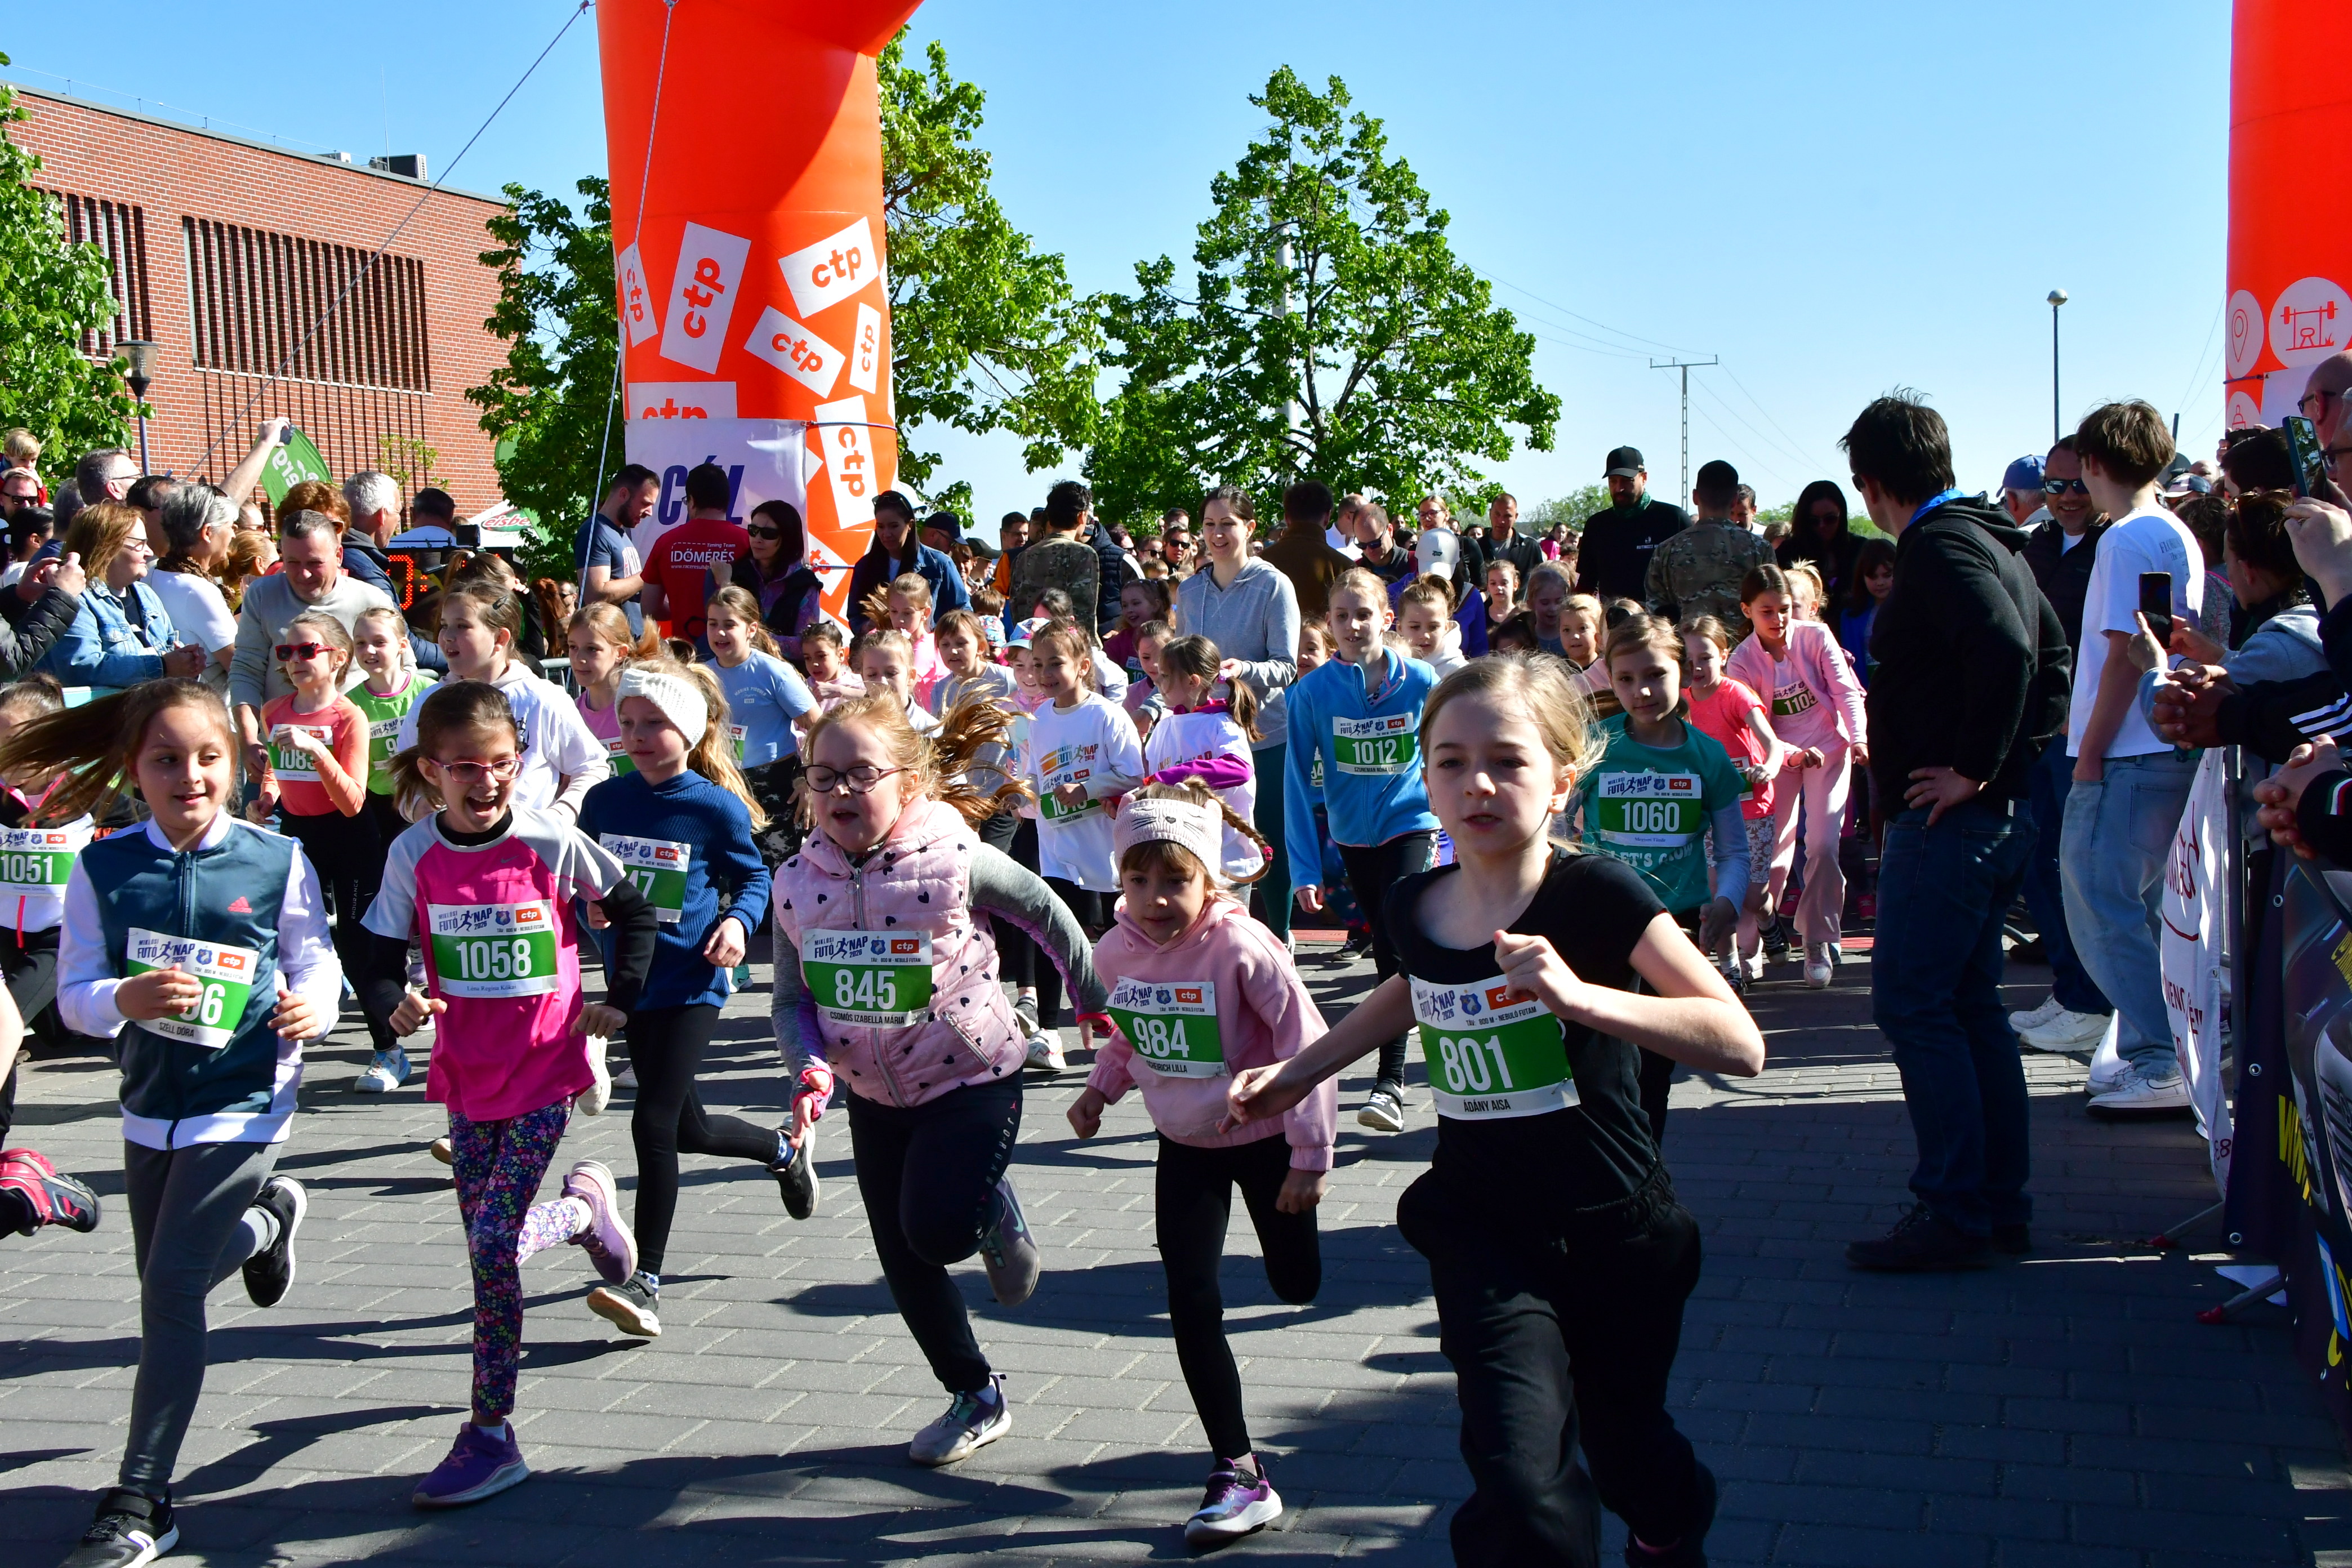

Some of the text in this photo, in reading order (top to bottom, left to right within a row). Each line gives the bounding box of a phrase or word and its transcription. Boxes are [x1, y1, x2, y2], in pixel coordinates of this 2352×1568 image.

[812, 247, 861, 288] ctp
[627, 268, 643, 322] ctp
[683, 257, 725, 338] ctp
[772, 333, 823, 372] ctp
[860, 324, 875, 372] ctp
[838, 426, 865, 497] ctp
[658, 455, 745, 525] CL
[671, 548, 734, 563] IDŐMÉRÉS
[809, 549, 831, 574] tp
[389, 719, 398, 728] NAP
[1340, 720, 1373, 734] FUTÓ NAP
[1084, 743, 1099, 755] NAP
[1352, 739, 1397, 764] 1012
[1608, 776, 1652, 795] FUTÓ NAP
[1050, 795, 1087, 816] 10
[1622, 801, 1680, 832] 1060
[15, 831, 29, 841] NAP
[624, 841, 638, 852] NAP
[1, 854, 53, 883] 1051
[439, 907, 492, 932] FUTÓ NAP
[521, 910, 538, 920] ctp
[474, 920, 487, 930] 2026
[814, 937, 834, 946] MIKLÓSI
[814, 936, 868, 958] FUTÓ NAP
[897, 942, 914, 951] ctp
[137, 943, 195, 959] FUTÓ NAP
[456, 938, 532, 979] 1058
[849, 949, 862, 958] 2026
[223, 956, 241, 967] ctp
[835, 969, 896, 1010] 845
[1114, 987, 1152, 1005] FUTÓ NAP
[1181, 992, 1197, 1000] ctp
[1438, 990, 1455, 1009] NAP
[830, 1011, 905, 1024] CSOMÓS IZABELLA MÁRIA
[1442, 1009, 1455, 1021] 2026
[1498, 1011, 1518, 1021] NEBULÓ
[1519, 1006, 1536, 1016] FUTAM
[159, 1021, 194, 1037] SZÉLL DÓRA
[1133, 1017, 1190, 1058] 984
[1171, 1064, 1187, 1073] LILLA
[1440, 1035, 1513, 1092] 801
[1464, 1099, 1511, 1112] ÁDÁNY AISA
